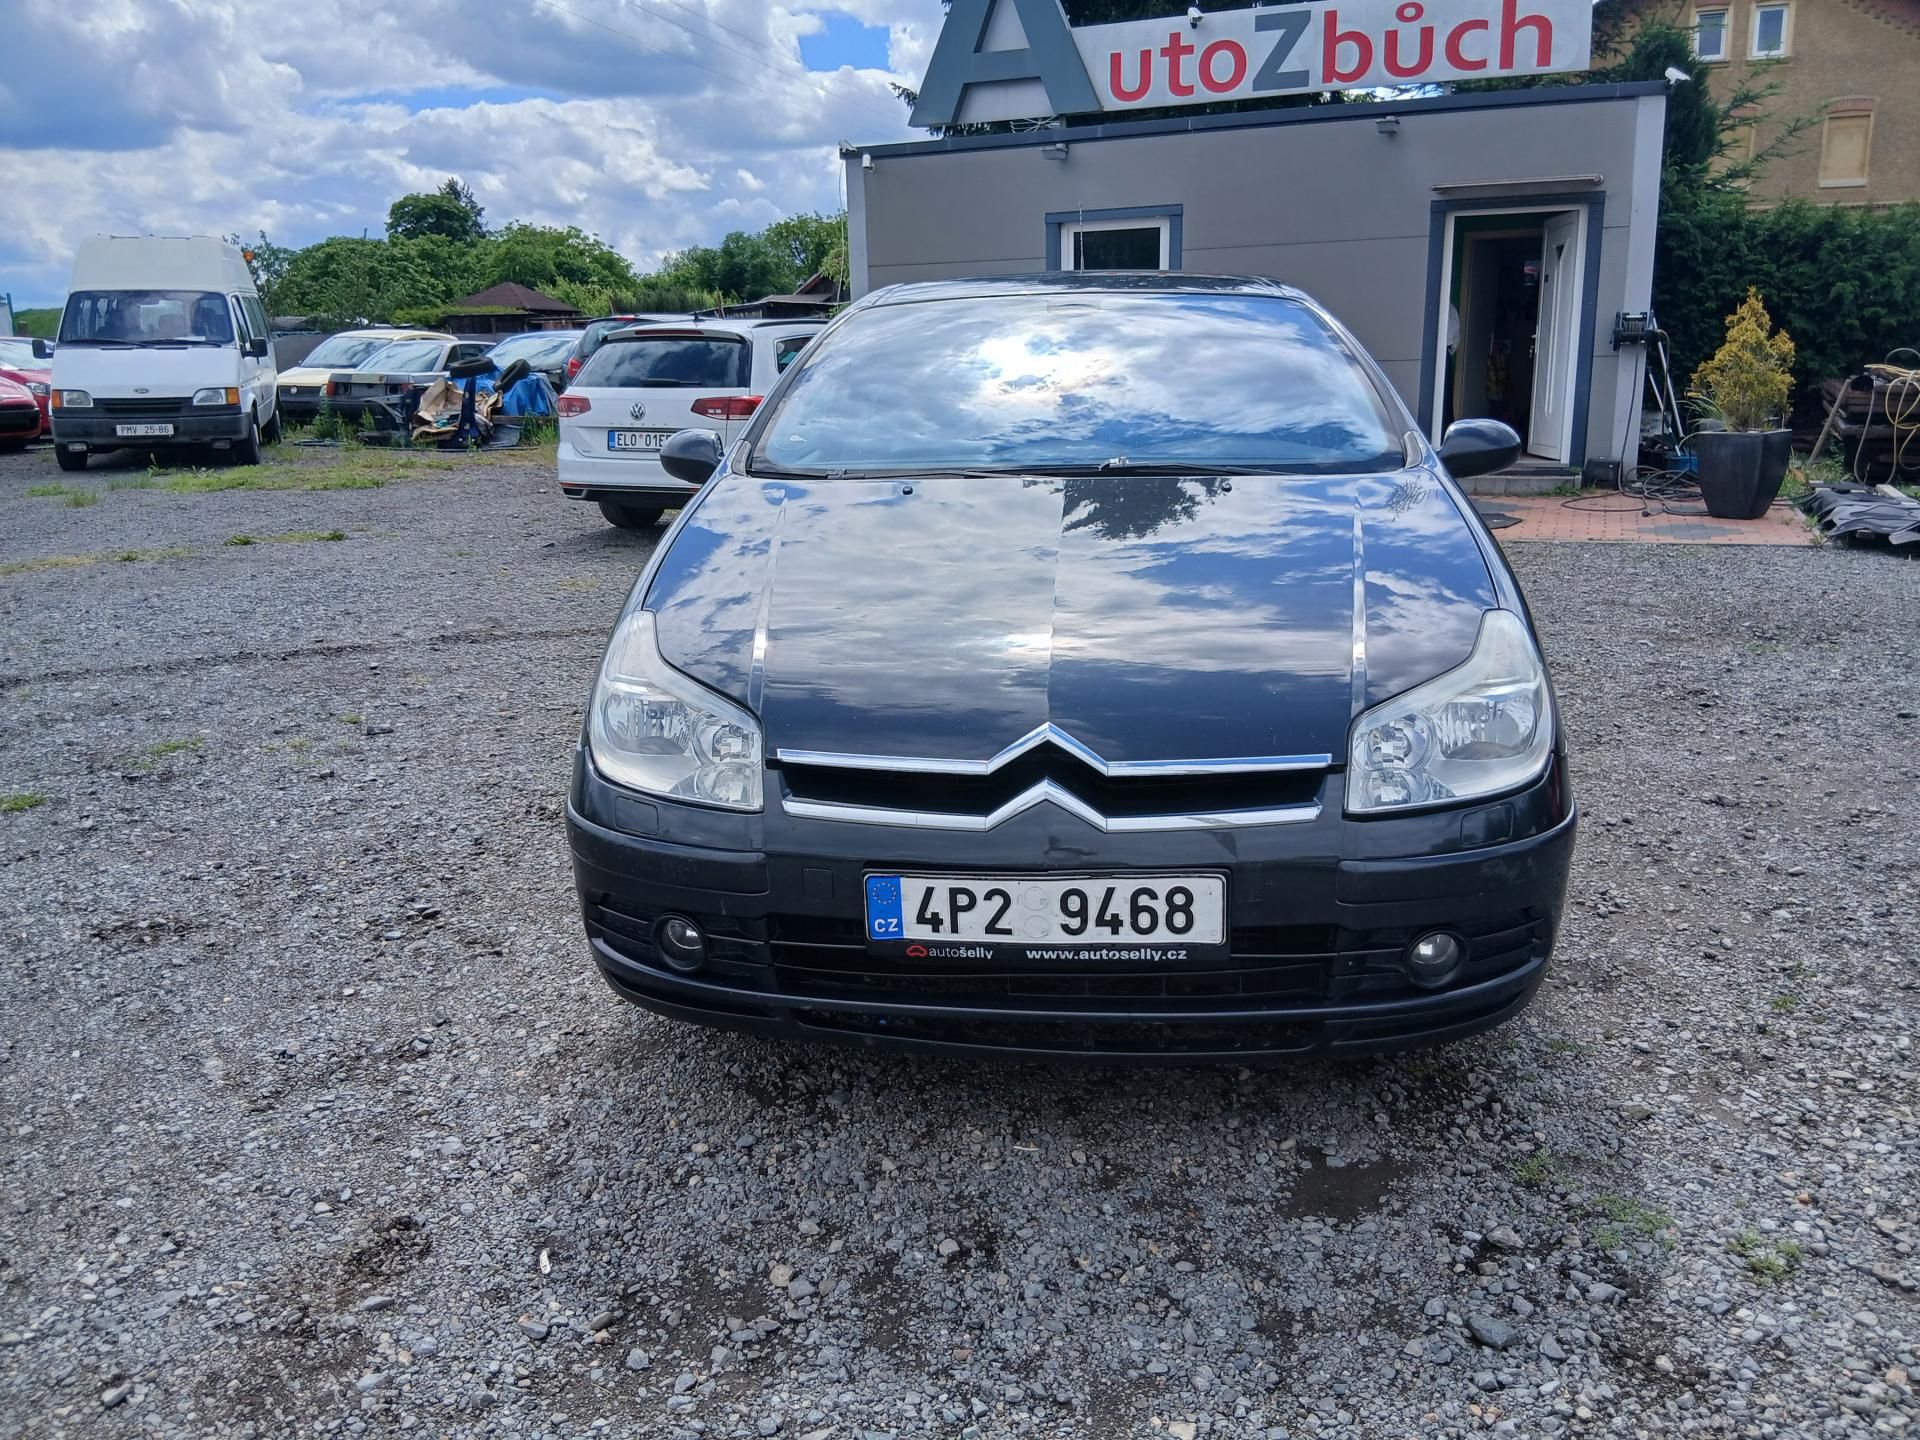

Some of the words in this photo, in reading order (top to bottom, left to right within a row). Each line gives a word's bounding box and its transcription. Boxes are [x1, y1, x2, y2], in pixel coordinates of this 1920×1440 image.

[120, 425, 137, 435] PMV
[144, 425, 170, 434] 25-86
[916, 886, 1013, 935] 4P2
[1060, 885, 1194, 936] 9468
[874, 918, 899, 933] CZ
[928, 946, 994, 960] autošelly
[1026, 948, 1188, 962] www.autoselly.cz
